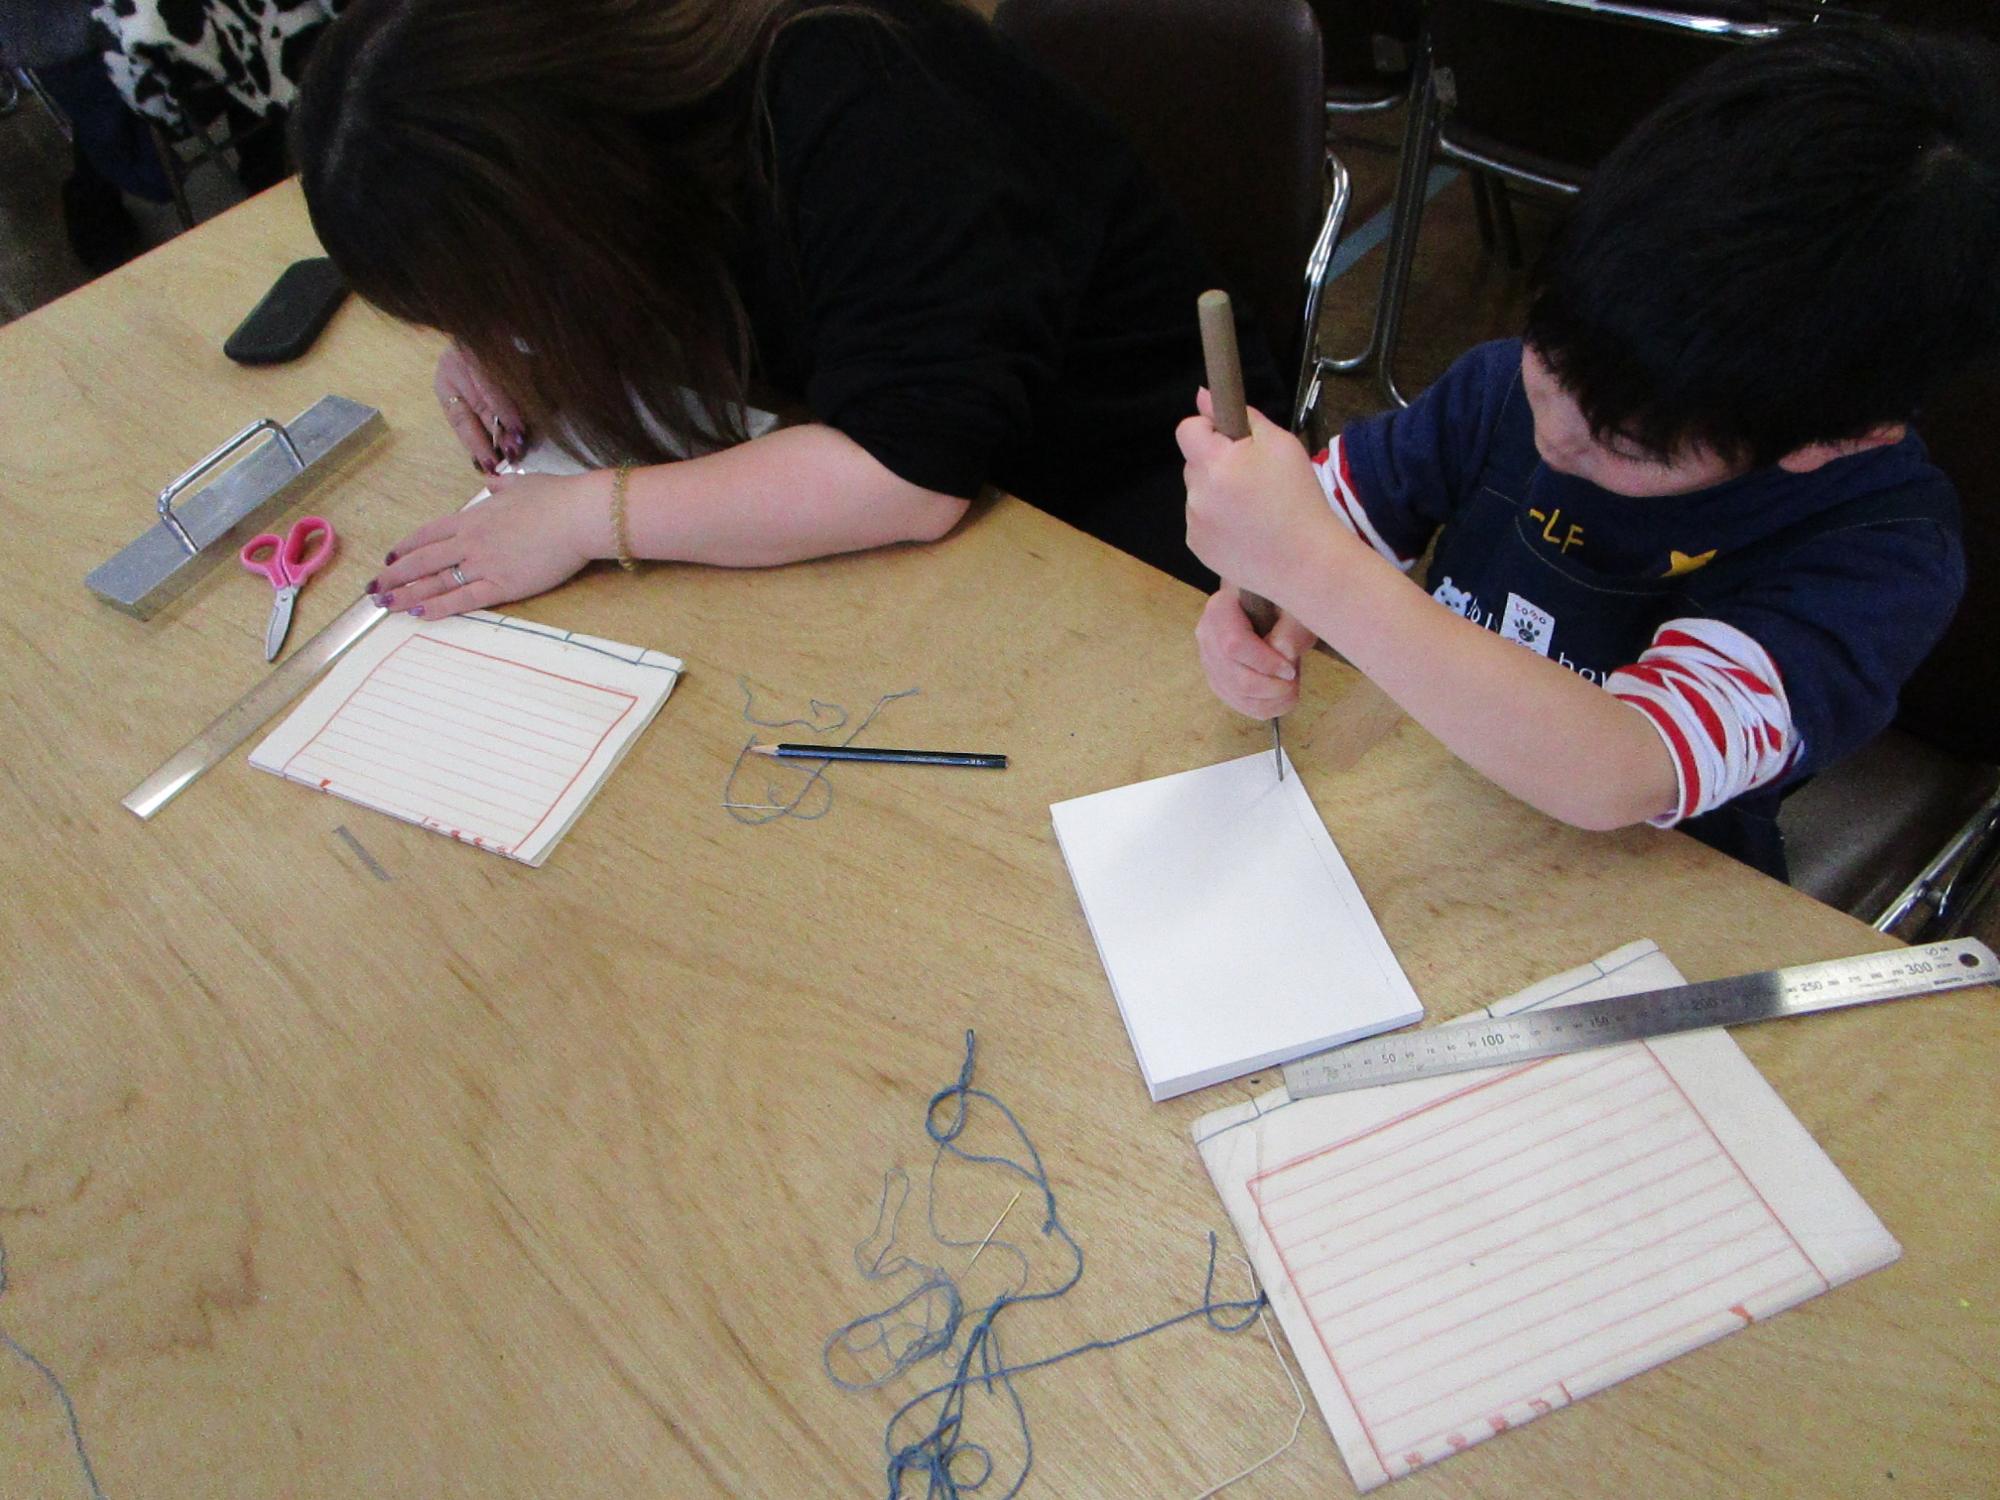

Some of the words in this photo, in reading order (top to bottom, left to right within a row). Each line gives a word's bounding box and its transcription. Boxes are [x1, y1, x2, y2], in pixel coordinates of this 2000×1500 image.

[1381, 1052, 1397, 1065] 50
[1481, 1033, 1505, 1047] 100
[1590, 1014, 1610, 1028] 150
[1800, 980, 1823, 992] 250
[1905, 961, 1933, 976] 300
